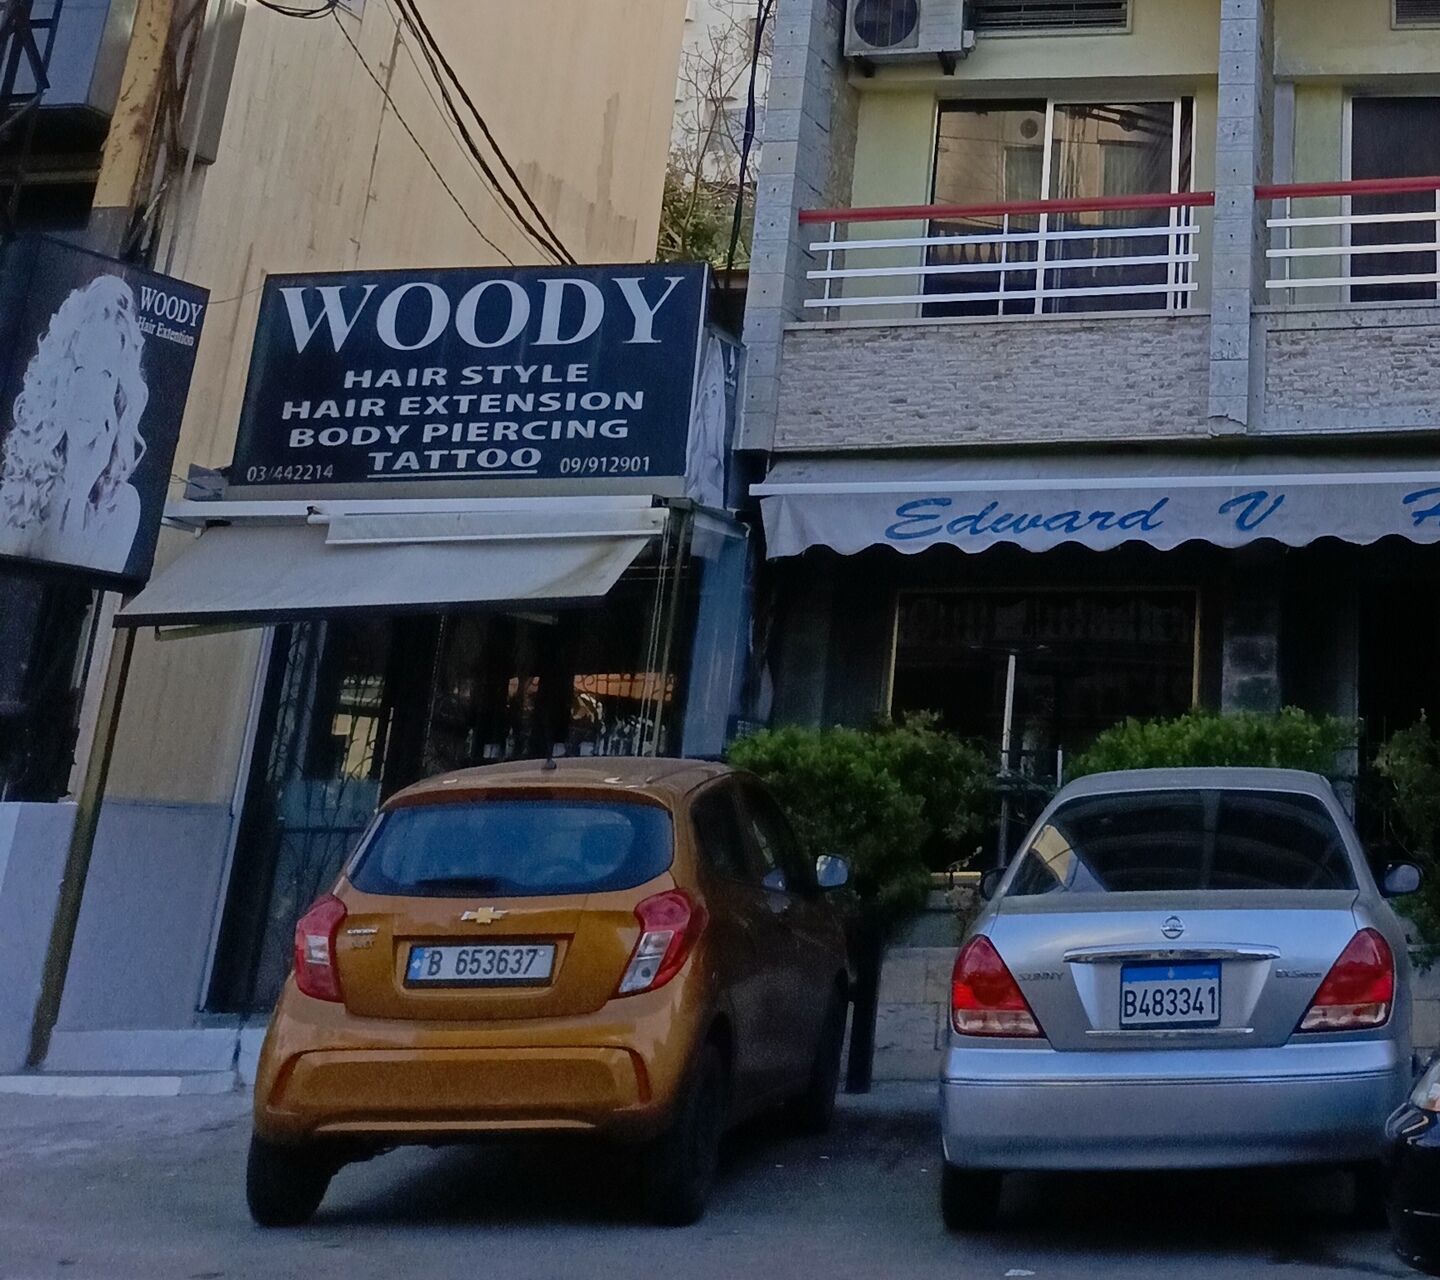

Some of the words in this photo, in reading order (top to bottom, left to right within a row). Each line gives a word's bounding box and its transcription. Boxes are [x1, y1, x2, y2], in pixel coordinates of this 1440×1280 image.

[141, 285, 203, 327] WOODY
[278, 276, 686, 354] WOODY
[344, 366, 448, 390] HAIR
[460, 363, 589, 386] STYLE
[282, 397, 385, 421] HAIR
[400, 390, 644, 415] EXTENSION
[289, 424, 408, 448] BODY
[422, 418, 629, 442] PIERCING
[246, 463, 333, 483] 03/442214
[560, 455, 651, 475] 09/912901
[367, 448, 542, 471] TATTOO
[884, 497, 1169, 541] Edward
[1219, 490, 1287, 534] V
[427, 951, 443, 976] B
[456, 949, 538, 976] 653637
[1124, 986, 1216, 1017] B483341
